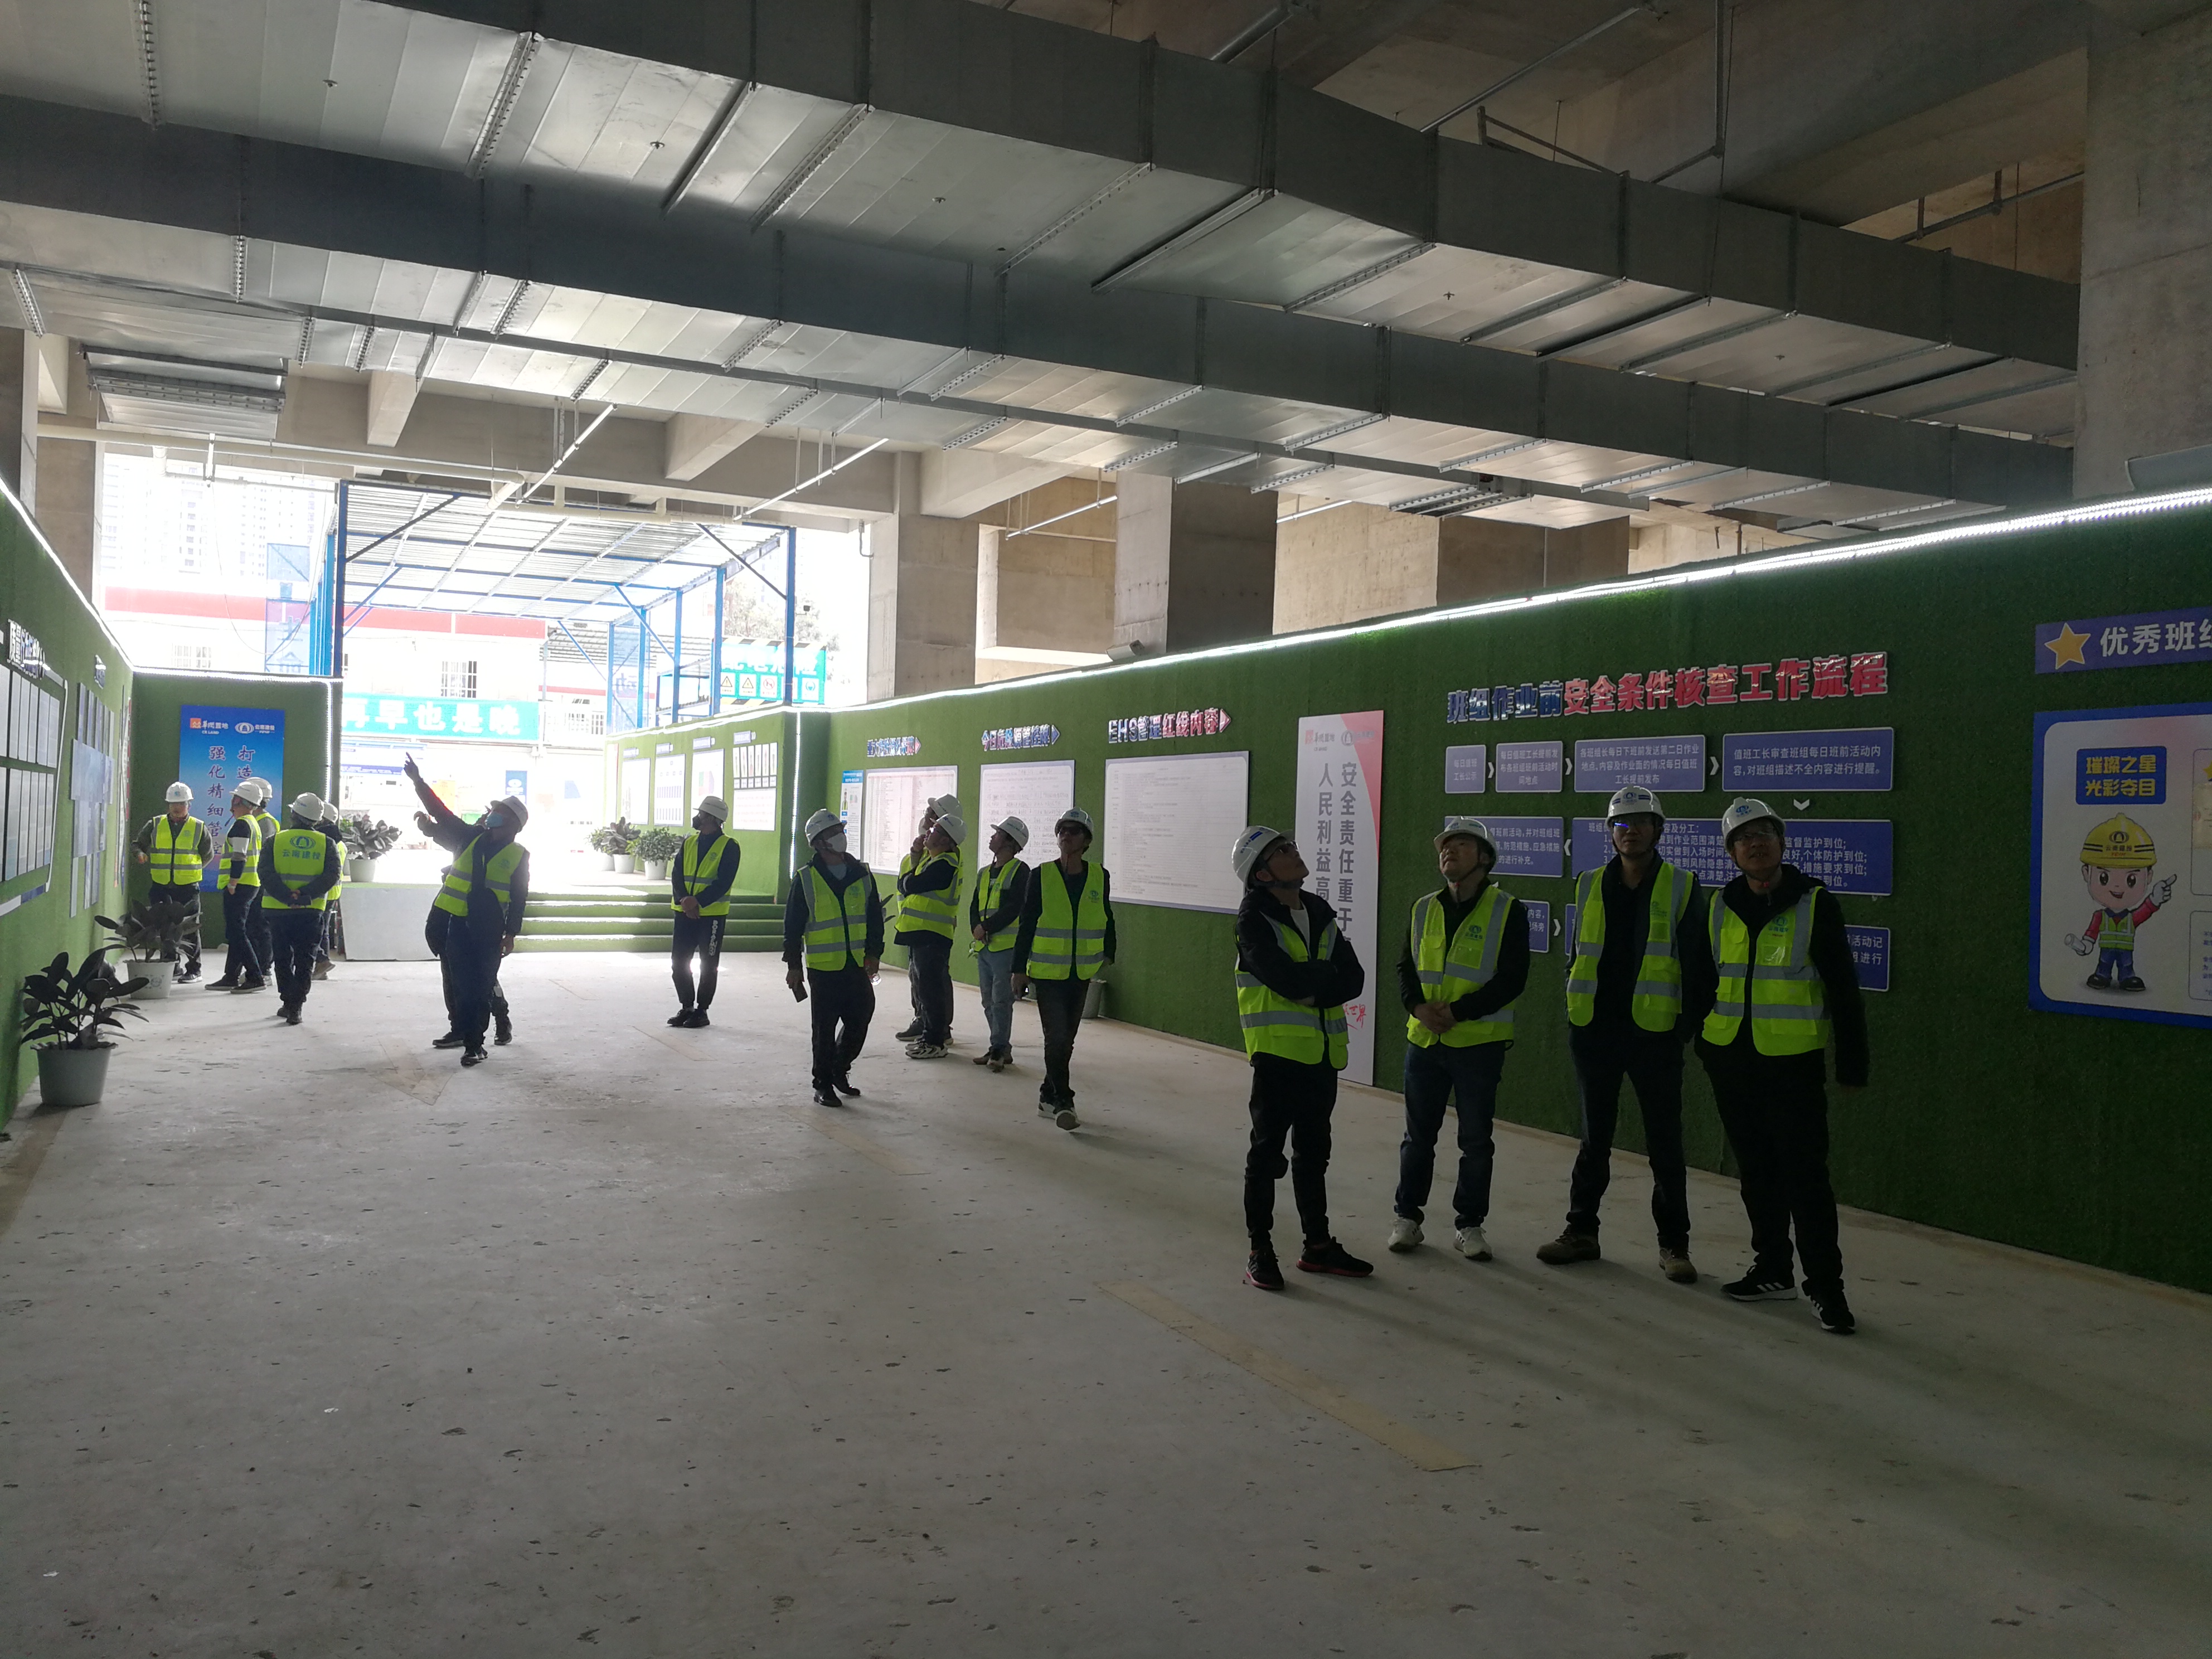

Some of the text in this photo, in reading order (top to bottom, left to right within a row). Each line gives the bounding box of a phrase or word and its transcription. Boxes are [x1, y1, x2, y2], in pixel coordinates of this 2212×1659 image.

[1447, 651, 1888, 724] 班组作业前安全条件核查工作流程
[1108, 707, 1219, 744] EHS管理红线内容
[1734, 745, 1881, 760] 值班工长审查班组每日班前活动内
[2085, 779, 2156, 797] 光彩夺目
[1337, 761, 1357, 941] 安全责任重于
[1658, 846, 1728, 857] 切实做到入场时间
[1846, 934, 1883, 948] 活动记
